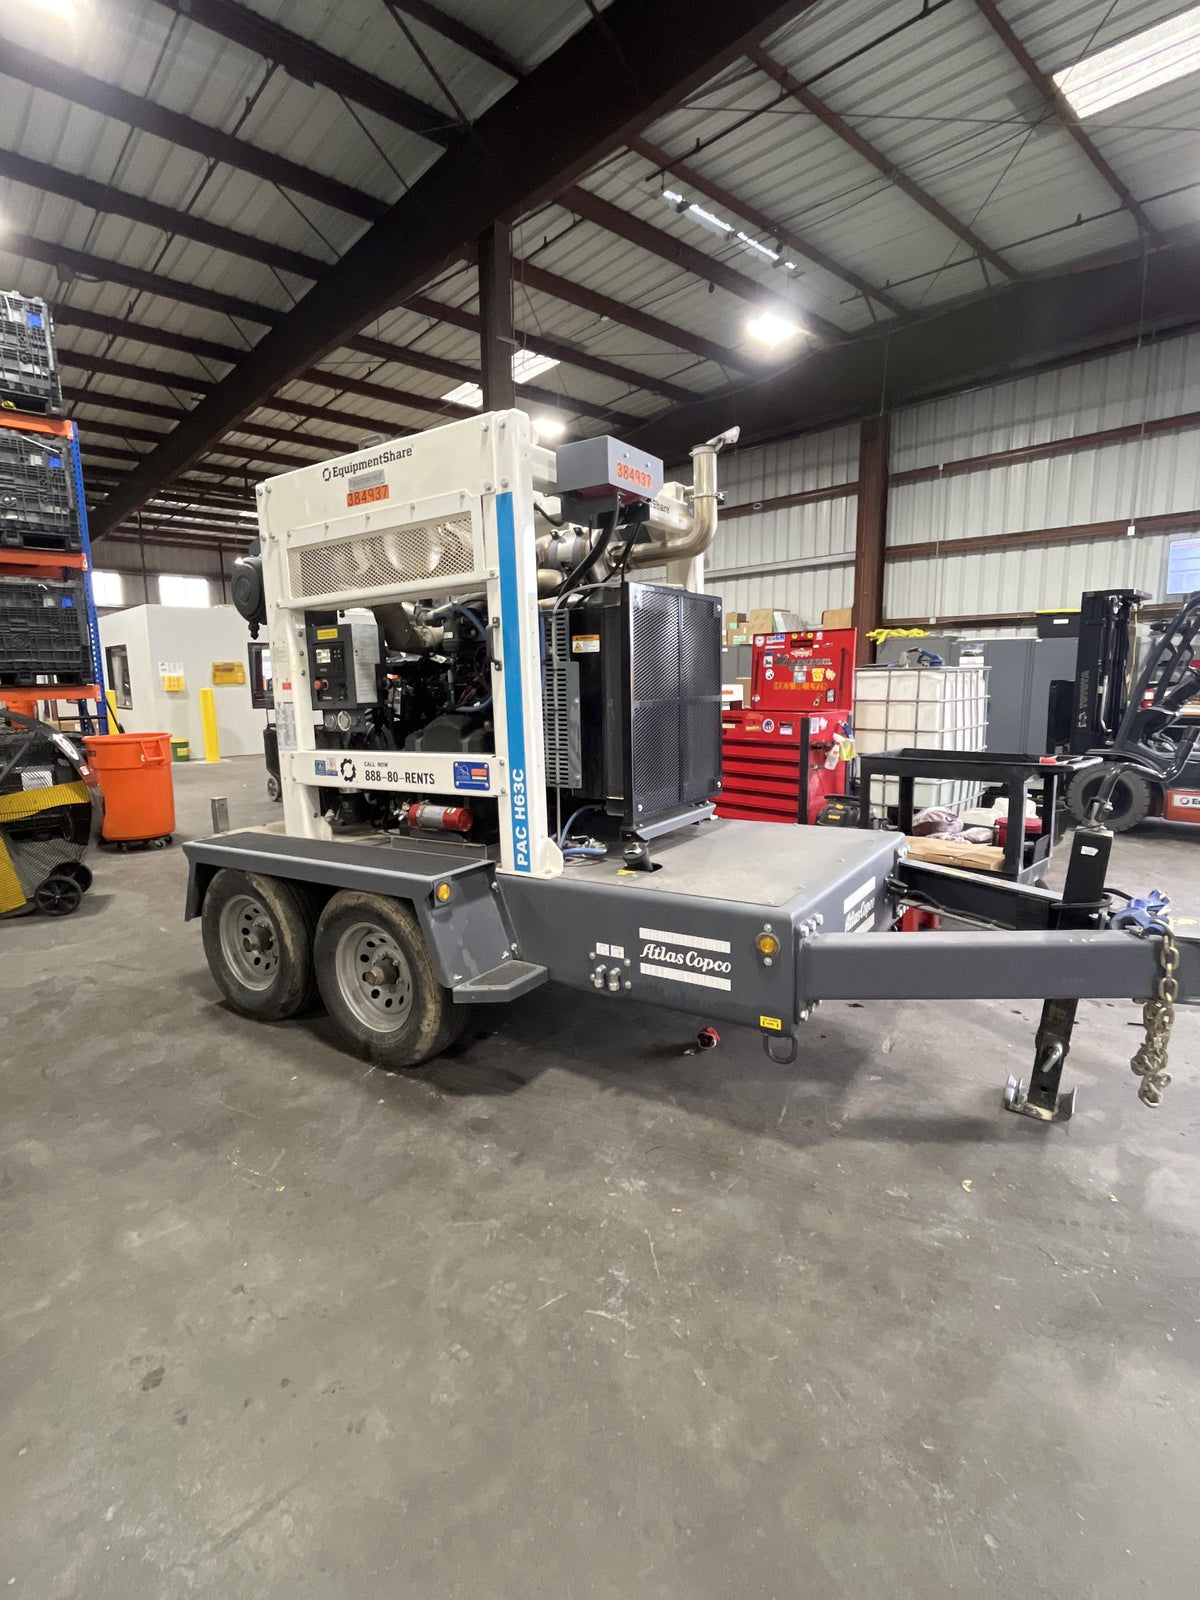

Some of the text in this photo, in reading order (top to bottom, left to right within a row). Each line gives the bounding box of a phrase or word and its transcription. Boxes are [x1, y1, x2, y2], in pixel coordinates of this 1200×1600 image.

[333, 448, 413, 478] EquipmentShare
[617, 461, 652, 489] 384937
[347, 485, 389, 507] 384937
[649, 497, 671, 514] Share
[365, 770, 436, 785] 888-80-RENTS
[512, 768, 529, 867] PAC H63C
[639, 942, 684, 966] Atlas
[684, 949, 732, 974] Copco
